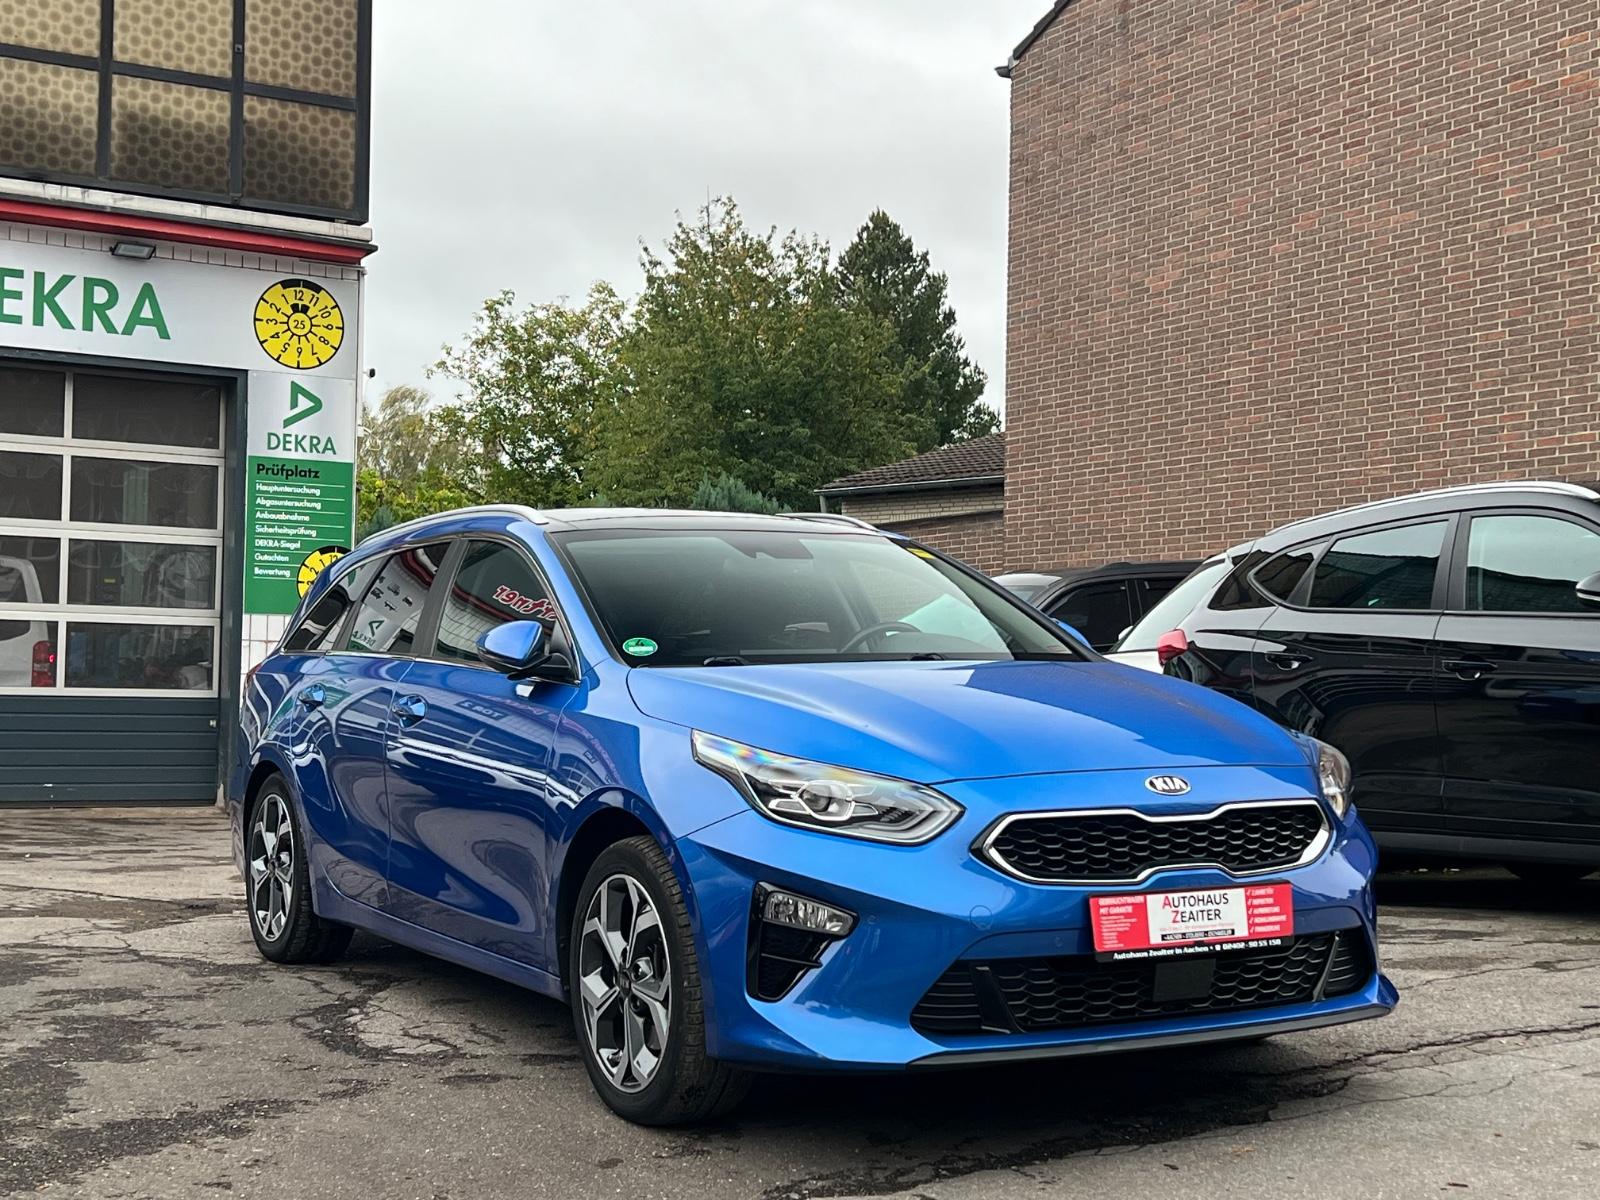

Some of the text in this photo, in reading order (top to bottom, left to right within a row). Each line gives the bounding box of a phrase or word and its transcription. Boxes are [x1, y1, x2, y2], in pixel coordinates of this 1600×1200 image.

[281, 294, 289, 304] 1
[293, 290, 304, 301] 12
[309, 293, 319, 307] 11
[270, 303, 281, 313] 2
[318, 305, 331, 319] 10
[293, 320, 305, 329] 25
[318, 336, 329, 345] 8
[280, 343, 290, 353] 5
[312, 344, 317, 356] 7
[267, 432, 337, 455] DEKRA
[257, 463, 320, 480] Prüfplatz
[256, 483, 320, 496] Hauptuntersuchung
[256, 497, 321, 510] Abgasuntersuchung
[256, 511, 310, 521] Anbauabnahme
[255, 525, 317, 538] Sicherheitsprüfung
[255, 539, 300, 550] DEKRA-Siegel
[255, 553, 289, 562] Gutachten
[254, 567, 290, 577] Bewertung
[1150, 777, 1188, 791] KIA
[1162, 893, 1229, 909] AUTOHAUS
[1171, 909, 1222, 923] ZEAITER
[1113, 951, 1148, 960] Autohaus
[1183, 945, 1209, 953] Aachen
